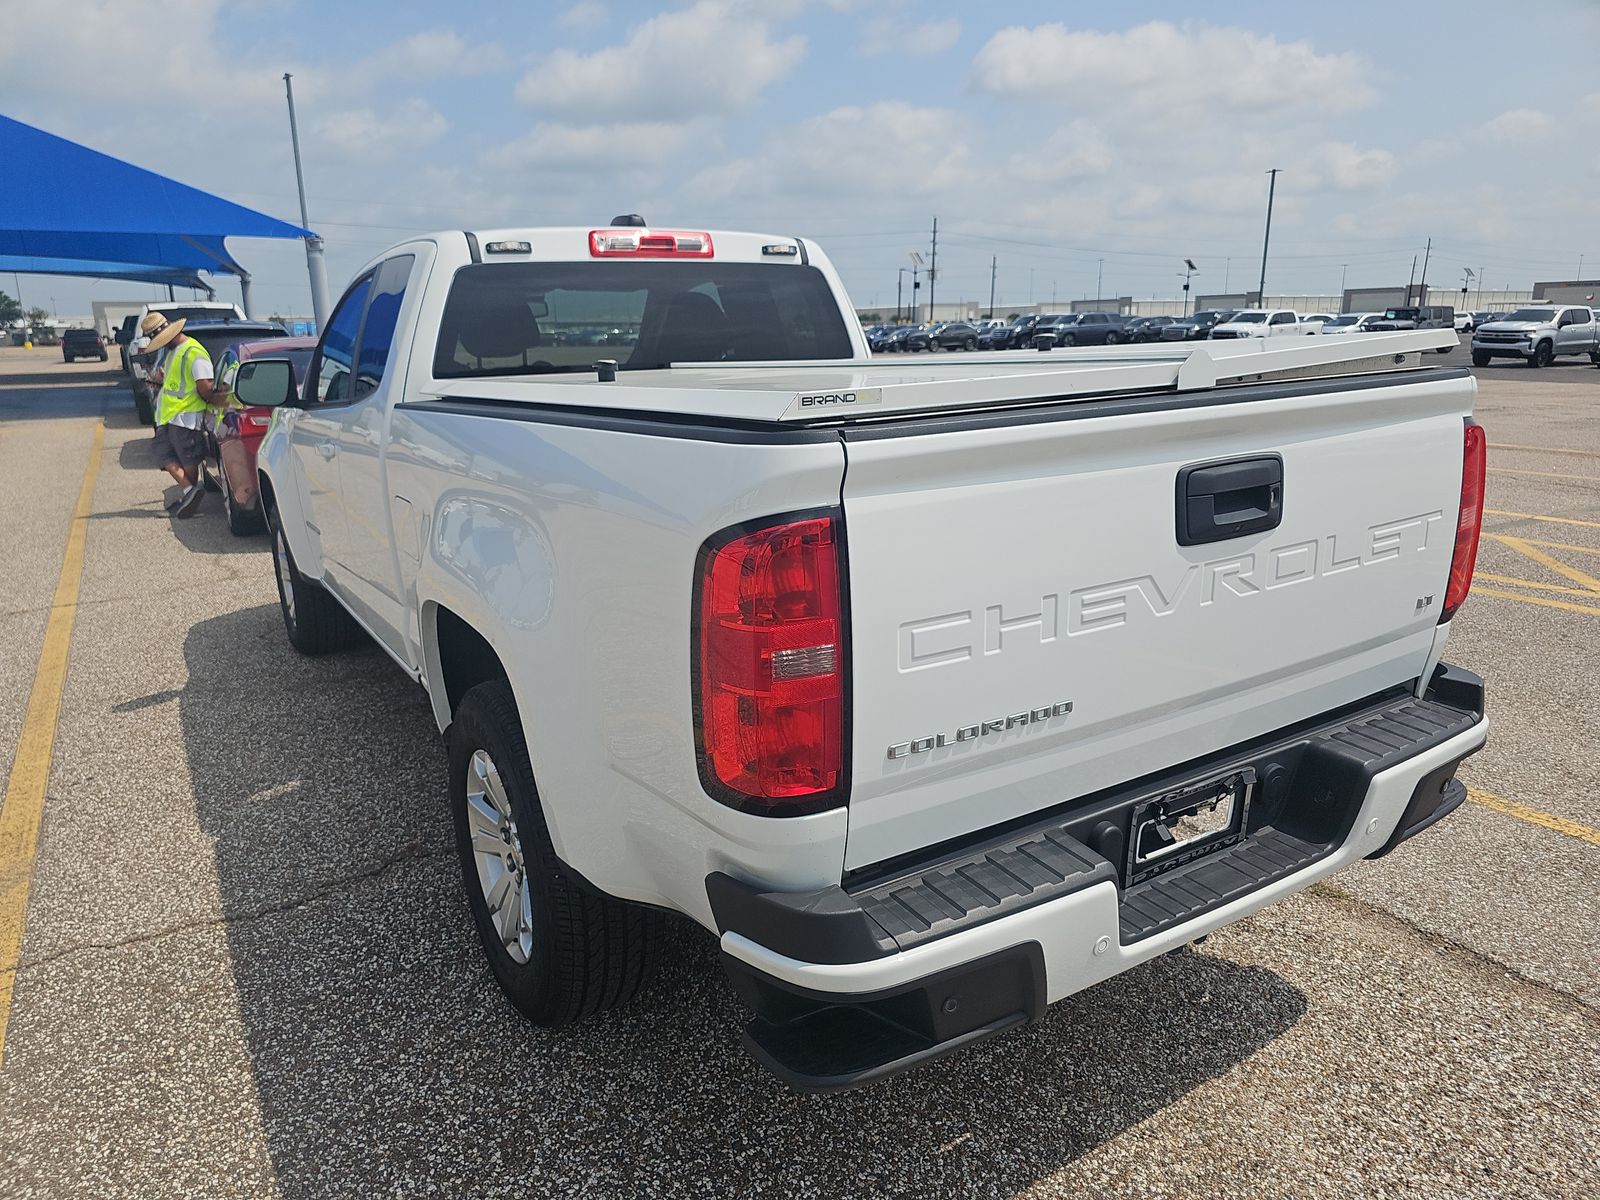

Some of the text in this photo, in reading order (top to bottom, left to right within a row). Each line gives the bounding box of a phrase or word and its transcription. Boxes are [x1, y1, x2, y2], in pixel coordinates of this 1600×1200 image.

[801, 393, 856, 407] BRAND
[897, 509, 1443, 674] CHEVROLET
[1415, 593, 1437, 609] LT
[887, 700, 1074, 759] COLORADO
